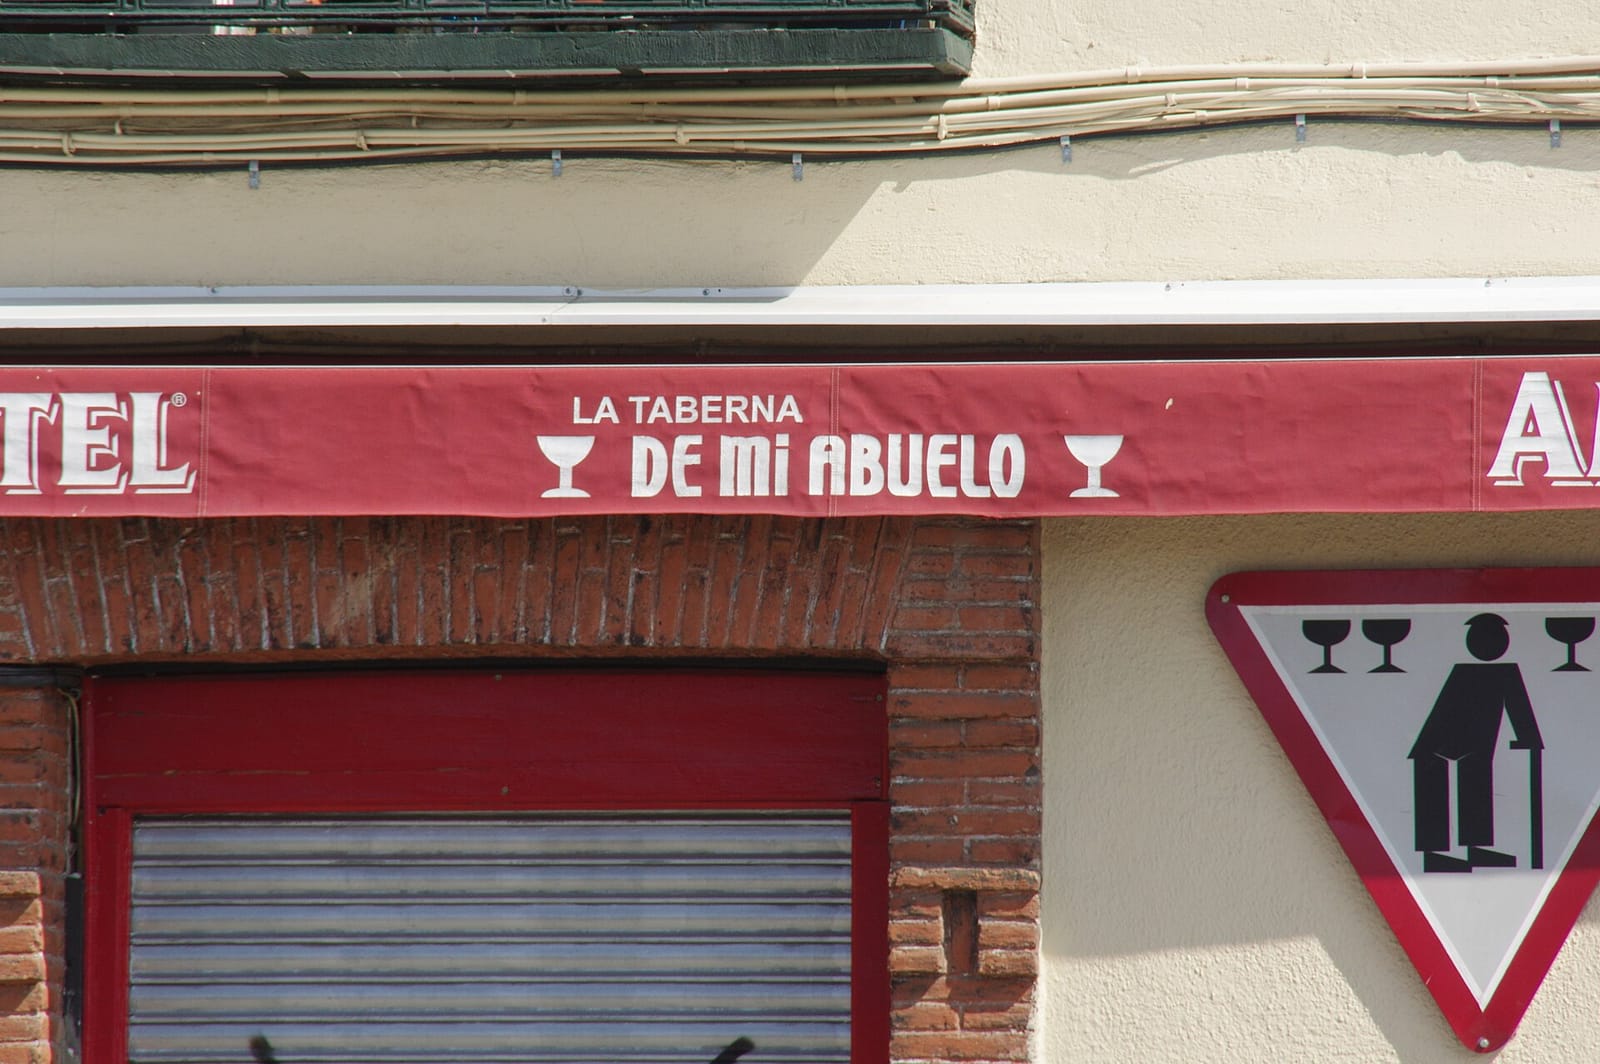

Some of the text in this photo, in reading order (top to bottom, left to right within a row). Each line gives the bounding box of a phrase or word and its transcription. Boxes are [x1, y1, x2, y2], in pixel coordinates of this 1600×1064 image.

[573, 395, 804, 424] LA TABERNA
[1486, 371, 1600, 487] A
[631, 434, 703, 498] DE
[808, 433, 1026, 498] ABUELO
